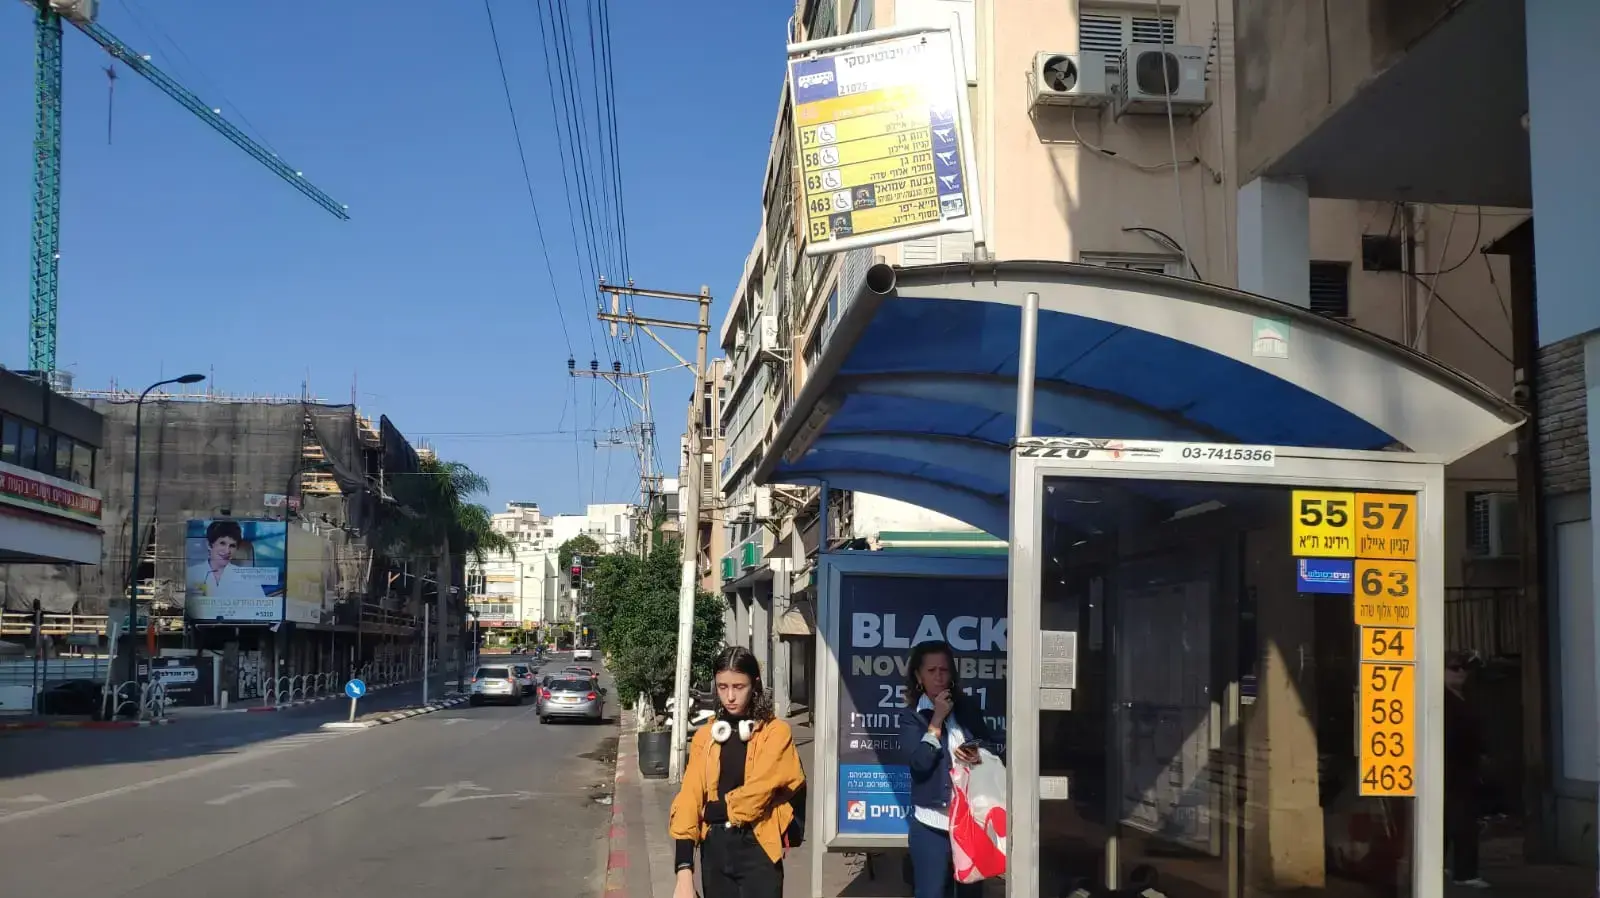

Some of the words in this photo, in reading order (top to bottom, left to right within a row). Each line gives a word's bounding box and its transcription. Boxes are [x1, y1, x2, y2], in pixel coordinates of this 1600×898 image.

[803, 130, 816, 144] 57
[805, 152, 819, 167] 58
[900, 156, 909, 167] גן
[913, 152, 931, 163] רמת
[808, 175, 821, 190] 63
[875, 180, 906, 194] שמואל
[810, 197, 831, 213] 463
[893, 213, 916, 225] רידינג
[918, 210, 938, 221] מסוף
[813, 221, 826, 237] 55
[1182, 447, 1272, 462] 03-7415356
[1300, 499, 1348, 528] 55
[1362, 502, 1409, 530] 57
[1323, 537, 1350, 550] רידינג
[1361, 534, 1385, 553] איילון
[1390, 538, 1410, 555] קניון
[1361, 568, 1409, 597] 63
[1360, 604, 1374, 617] שדה
[1377, 601, 1391, 621] אלוף
[1394, 605, 1410, 621] מסוף
[852, 612, 1008, 652] BLACK
[1371, 630, 1404, 656] 54
[852, 654, 1008, 680] NOVBER
[1371, 666, 1403, 692] 57
[1371, 699, 1404, 725] 58
[1371, 732, 1404, 758] 63
[1362, 765, 1413, 791] 463
